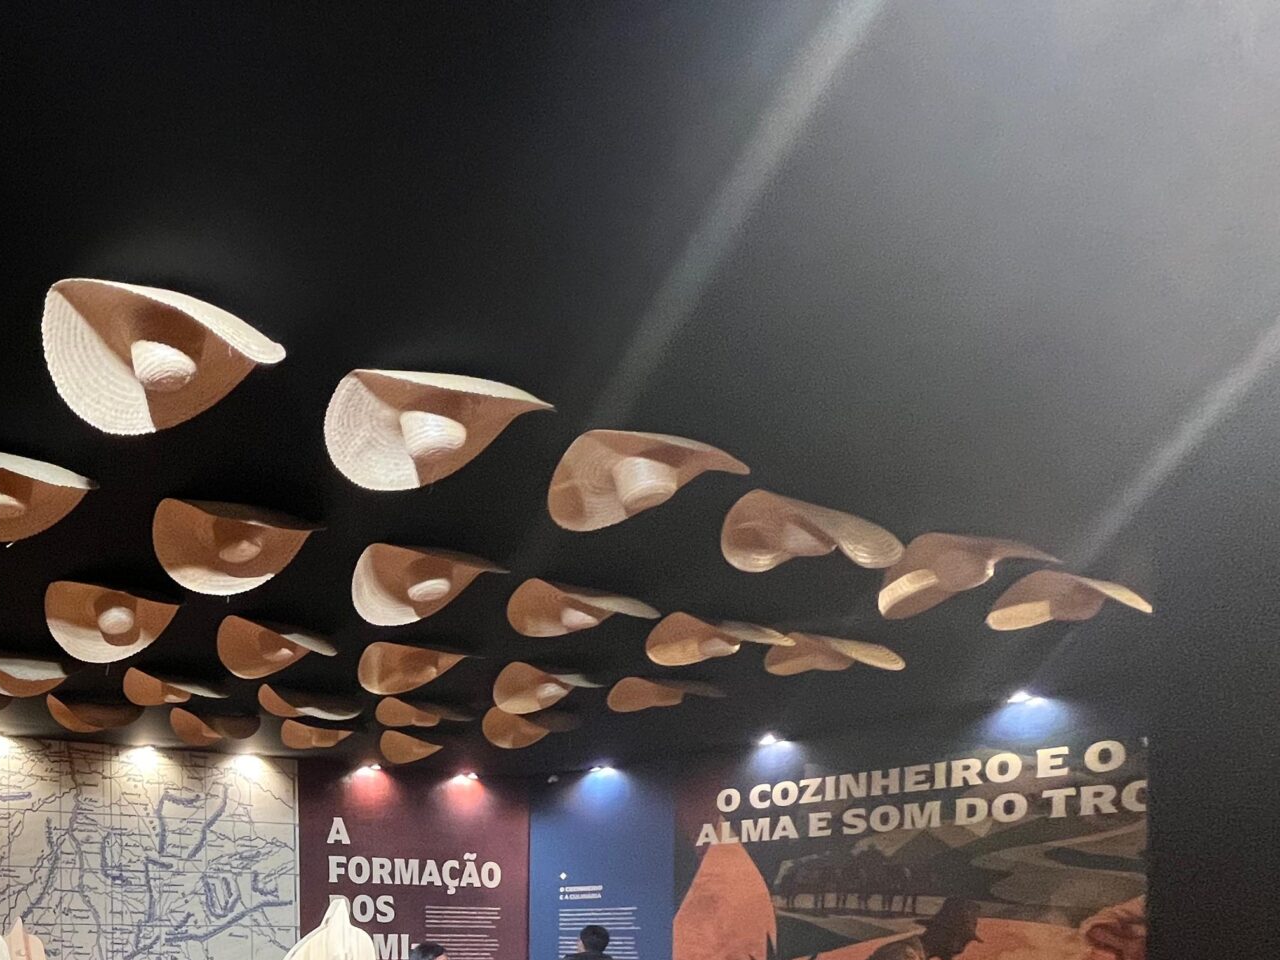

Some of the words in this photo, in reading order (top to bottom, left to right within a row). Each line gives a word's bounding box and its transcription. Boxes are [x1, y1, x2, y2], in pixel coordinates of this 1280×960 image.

[716, 788, 741, 813] O
[749, 752, 1022, 809] COZINHEIRO
[1035, 746, 1069, 778] E
[1084, 740, 1126, 773] O
[326, 817, 351, 844] A
[696, 815, 799, 847] ALMA
[808, 811, 832, 838] E
[842, 800, 942, 836] SOM
[954, 792, 1029, 826] DO
[327, 852, 502, 895] FORMAÇÃO
[373, 933, 421, 960] MI-
